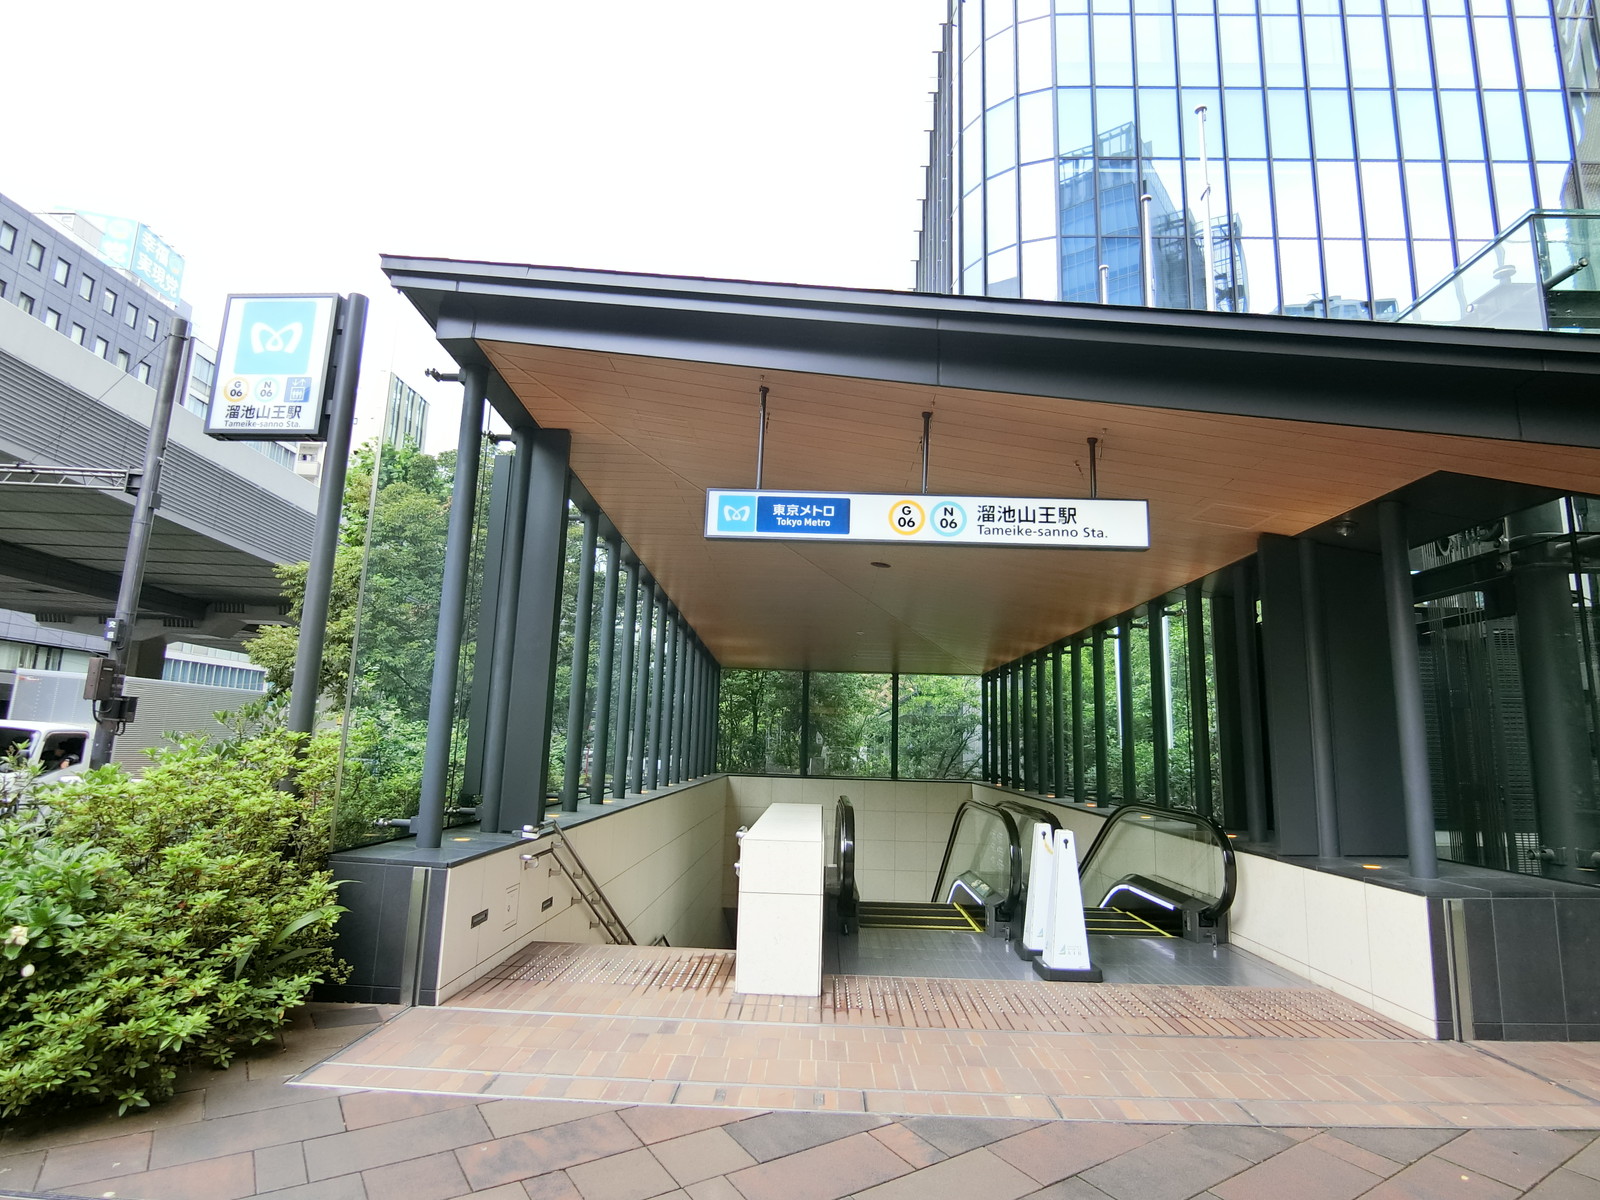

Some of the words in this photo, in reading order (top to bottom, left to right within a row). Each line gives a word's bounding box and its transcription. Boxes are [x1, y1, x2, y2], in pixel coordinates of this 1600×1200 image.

[230, 389, 243, 397] 06
[260, 389, 273, 397] 06
[225, 405, 302, 419] 溜池山王駅
[224, 420, 284, 428] Tameike-sanno
[772, 504, 835, 517] 東京メトロ
[902, 506, 912, 516] G
[943, 507, 954, 517] N
[977, 504, 1077, 524] 溜池山王駅
[776, 517, 802, 527] Tokyo
[804, 518, 831, 527] Metro
[898, 517, 916, 528] 06
[940, 518, 958, 529] 06
[977, 525, 1079, 537] Tameike-sanno
[1083, 527, 1108, 538] Sta.
